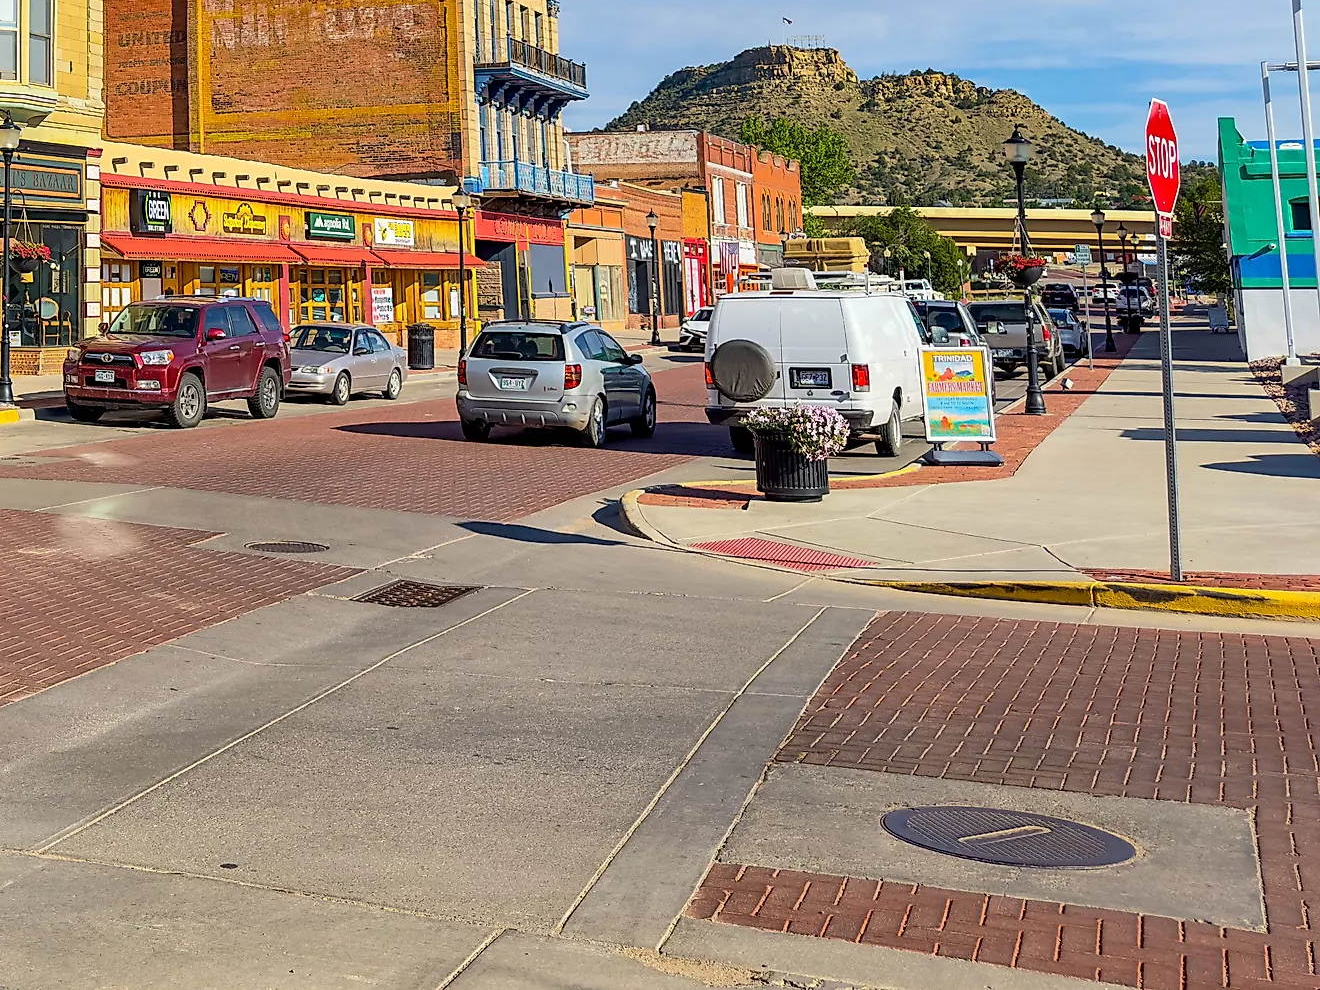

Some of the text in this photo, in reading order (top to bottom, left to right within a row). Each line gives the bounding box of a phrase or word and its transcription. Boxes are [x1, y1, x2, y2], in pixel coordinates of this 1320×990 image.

[118, 30, 187, 47] UNITED
[115, 79, 188, 96] COUPON
[1148, 134, 1177, 179] STOP
[33, 173, 74, 190] BAZAAR
[148, 200, 169, 220] GREEN
[314, 216, 341, 230] Magnolia
[932, 354, 973, 363] TRINIDAD
[956, 381, 983, 392] MARKET
